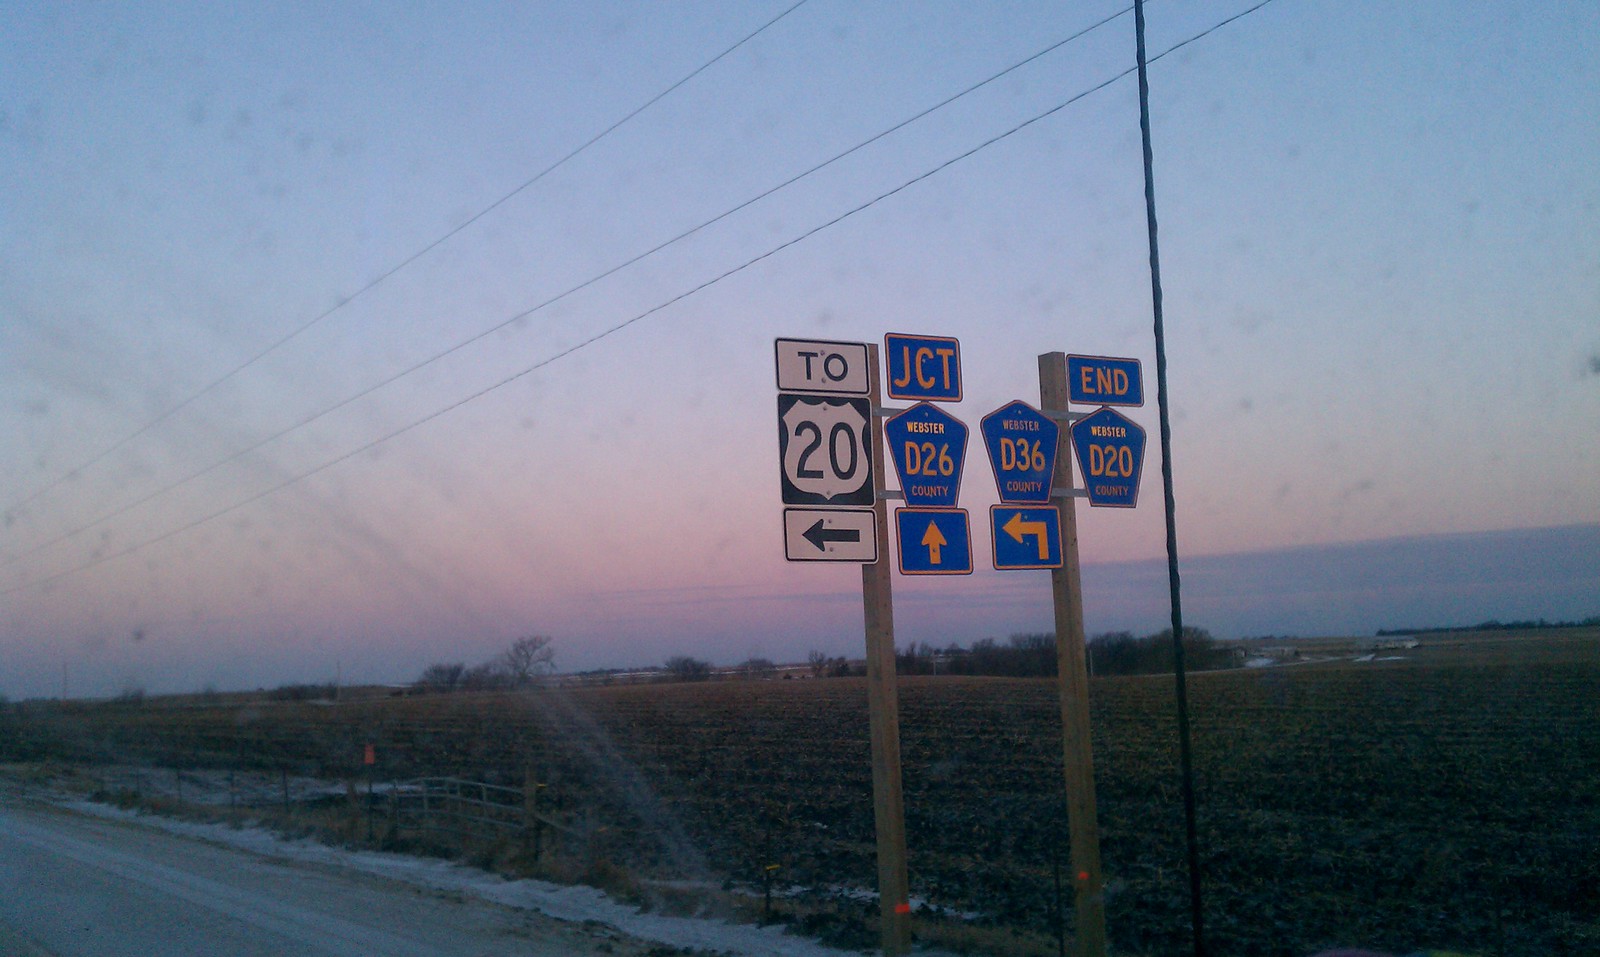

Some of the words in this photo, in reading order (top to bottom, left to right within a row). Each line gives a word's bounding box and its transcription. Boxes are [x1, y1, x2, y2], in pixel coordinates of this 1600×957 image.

[798, 352, 848, 381] TO
[894, 346, 954, 390] JCT
[1081, 366, 1129, 395] END
[907, 421, 944, 434] WEBSTER
[1003, 420, 1039, 431] WEBSTER
[1091, 426, 1126, 438] WEBSTER
[795, 421, 857, 480] 20
[905, 441, 954, 476] D26
[1000, 437, 1046, 472] D36
[1089, 444, 1133, 478] D20
[911, 485, 949, 497] COUNTY
[1006, 481, 1042, 492] COUNTY
[1095, 485, 1129, 497] COUNTY
